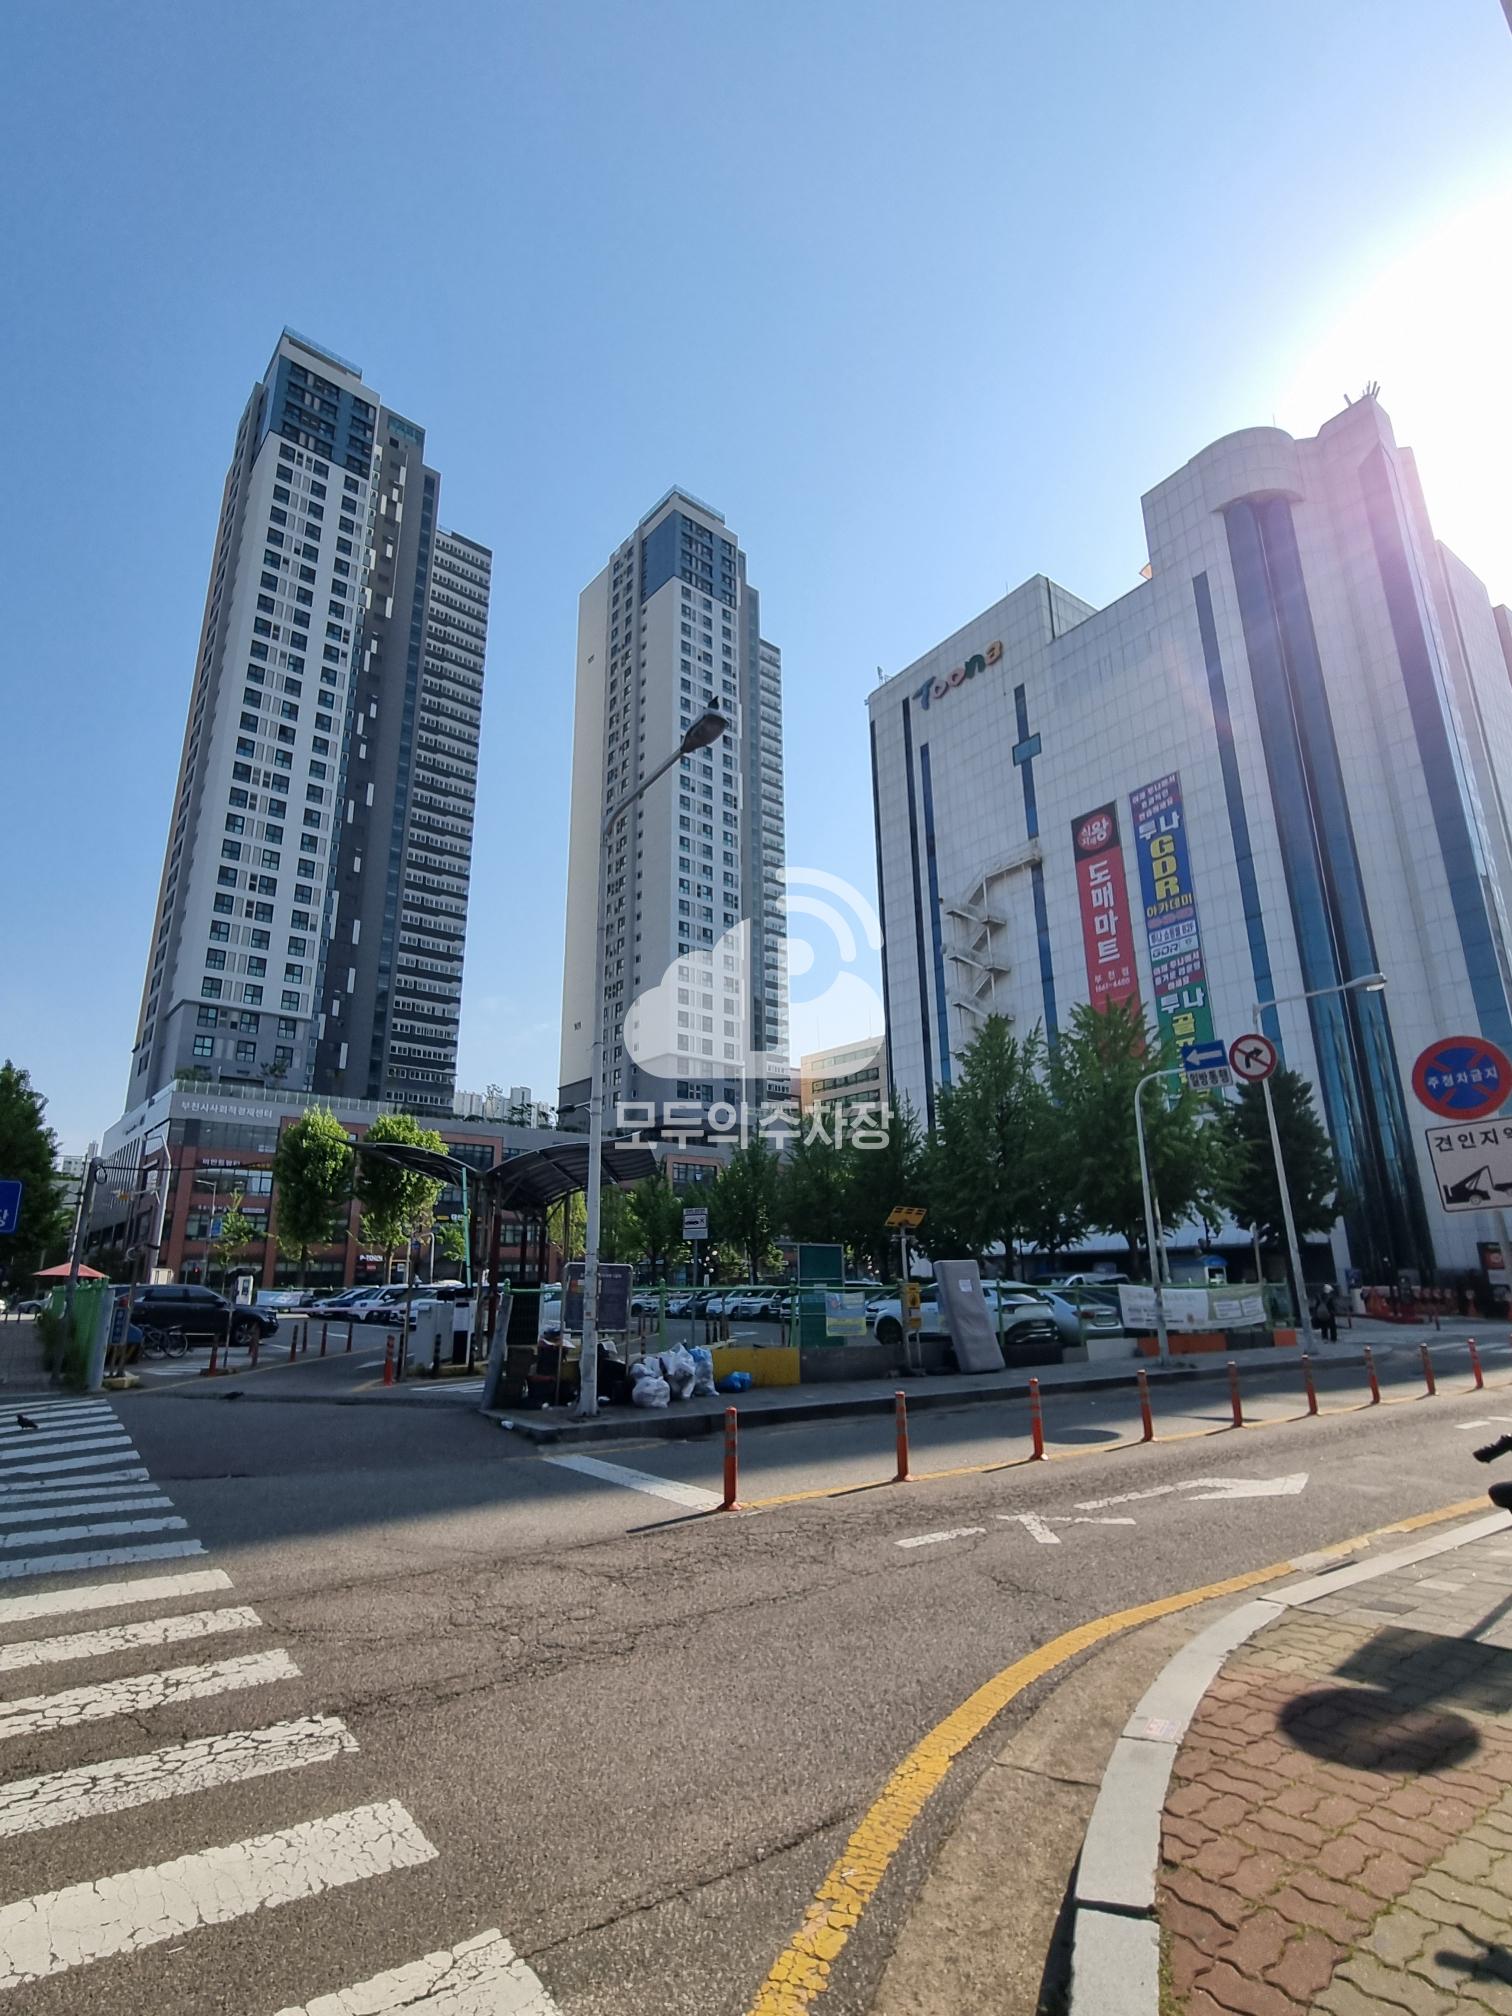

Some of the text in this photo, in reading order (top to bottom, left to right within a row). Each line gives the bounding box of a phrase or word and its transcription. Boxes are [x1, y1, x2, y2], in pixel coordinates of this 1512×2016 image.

[1138, 810, 1180, 840] 투나
[1150, 835, 1180, 901] GDR
[1088, 859, 1120, 964] 도매마트
[1146, 892, 1193, 918] 아카데미
[1161, 987, 1204, 1014] 투나
[1189, 1068, 1230, 1088] 일방통행
[1427, 1064, 1498, 1089] 주정차금지
